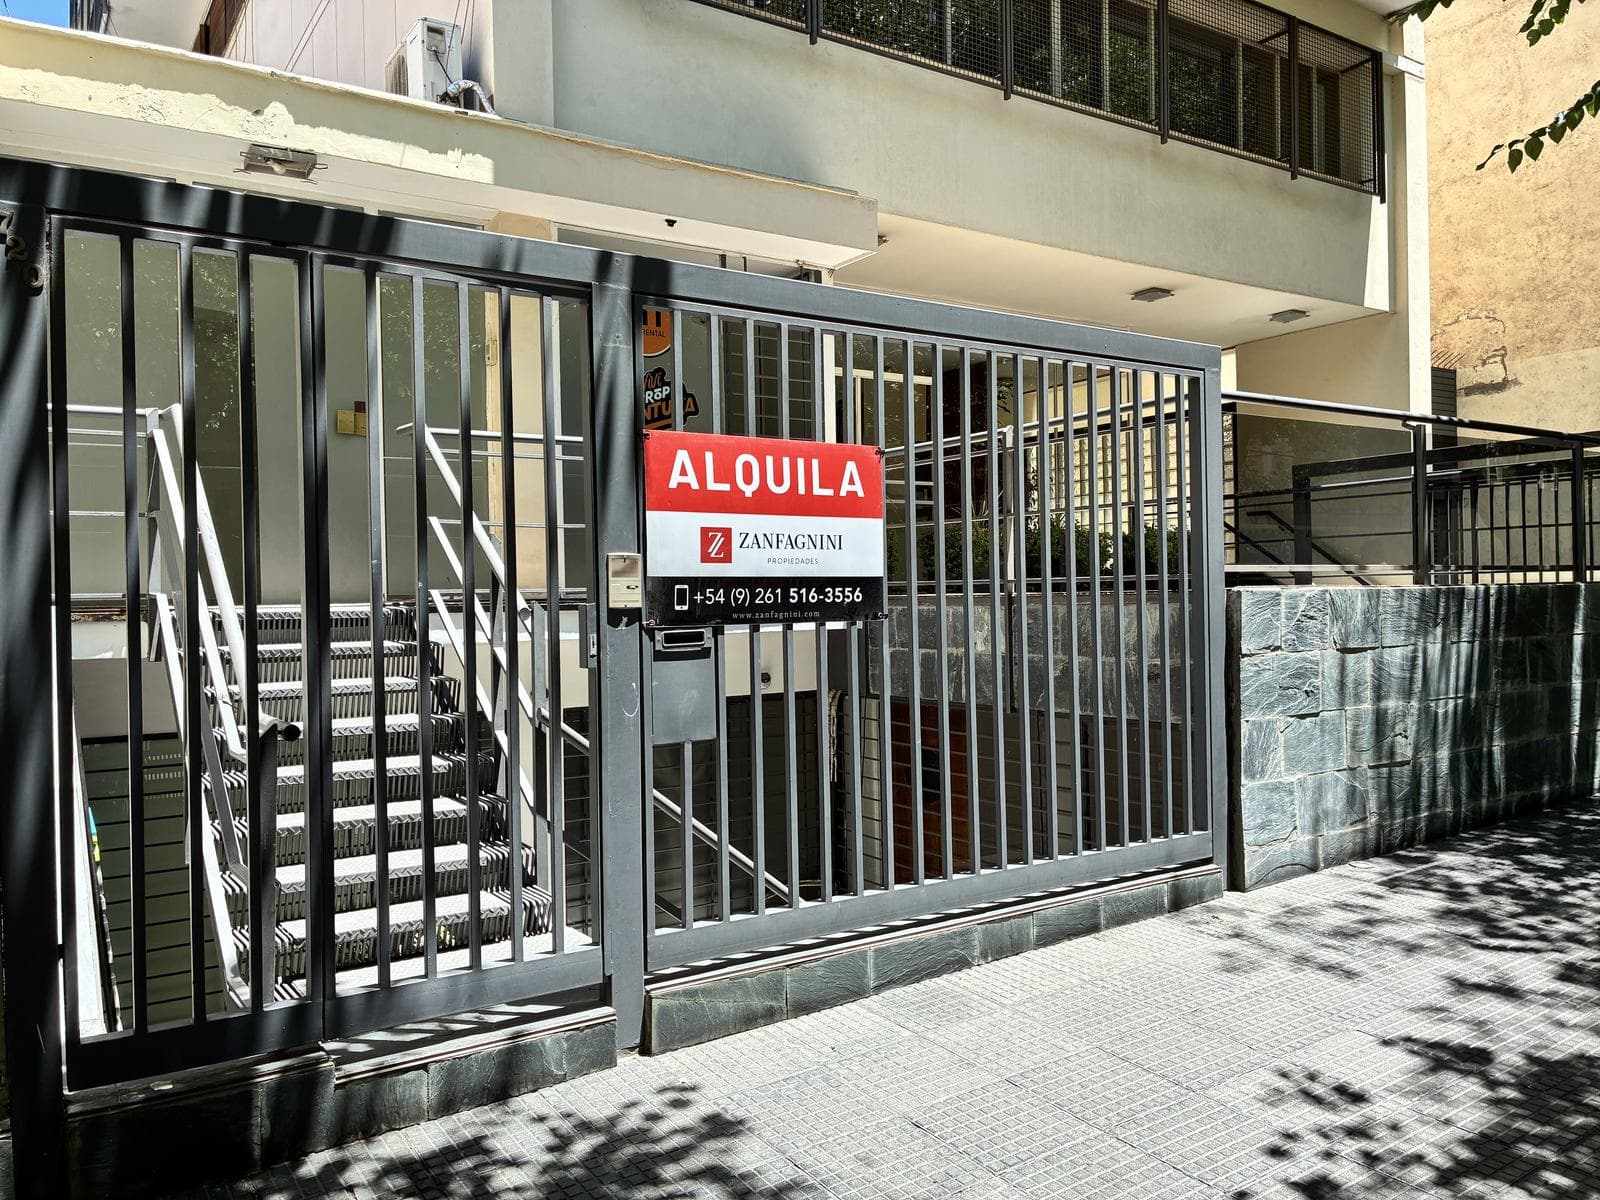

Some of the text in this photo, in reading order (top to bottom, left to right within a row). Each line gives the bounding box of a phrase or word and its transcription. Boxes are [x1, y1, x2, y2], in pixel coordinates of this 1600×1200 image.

[668, 449, 865, 498] ALQUILA
[738, 532, 844, 551] ZANFAGNINI
[767, 557, 819, 565] PROPIEDADES
[693, 587, 863, 607] +54 (9) 261 516-3556
[732, 610, 820, 619] www.zanfagnini.com
